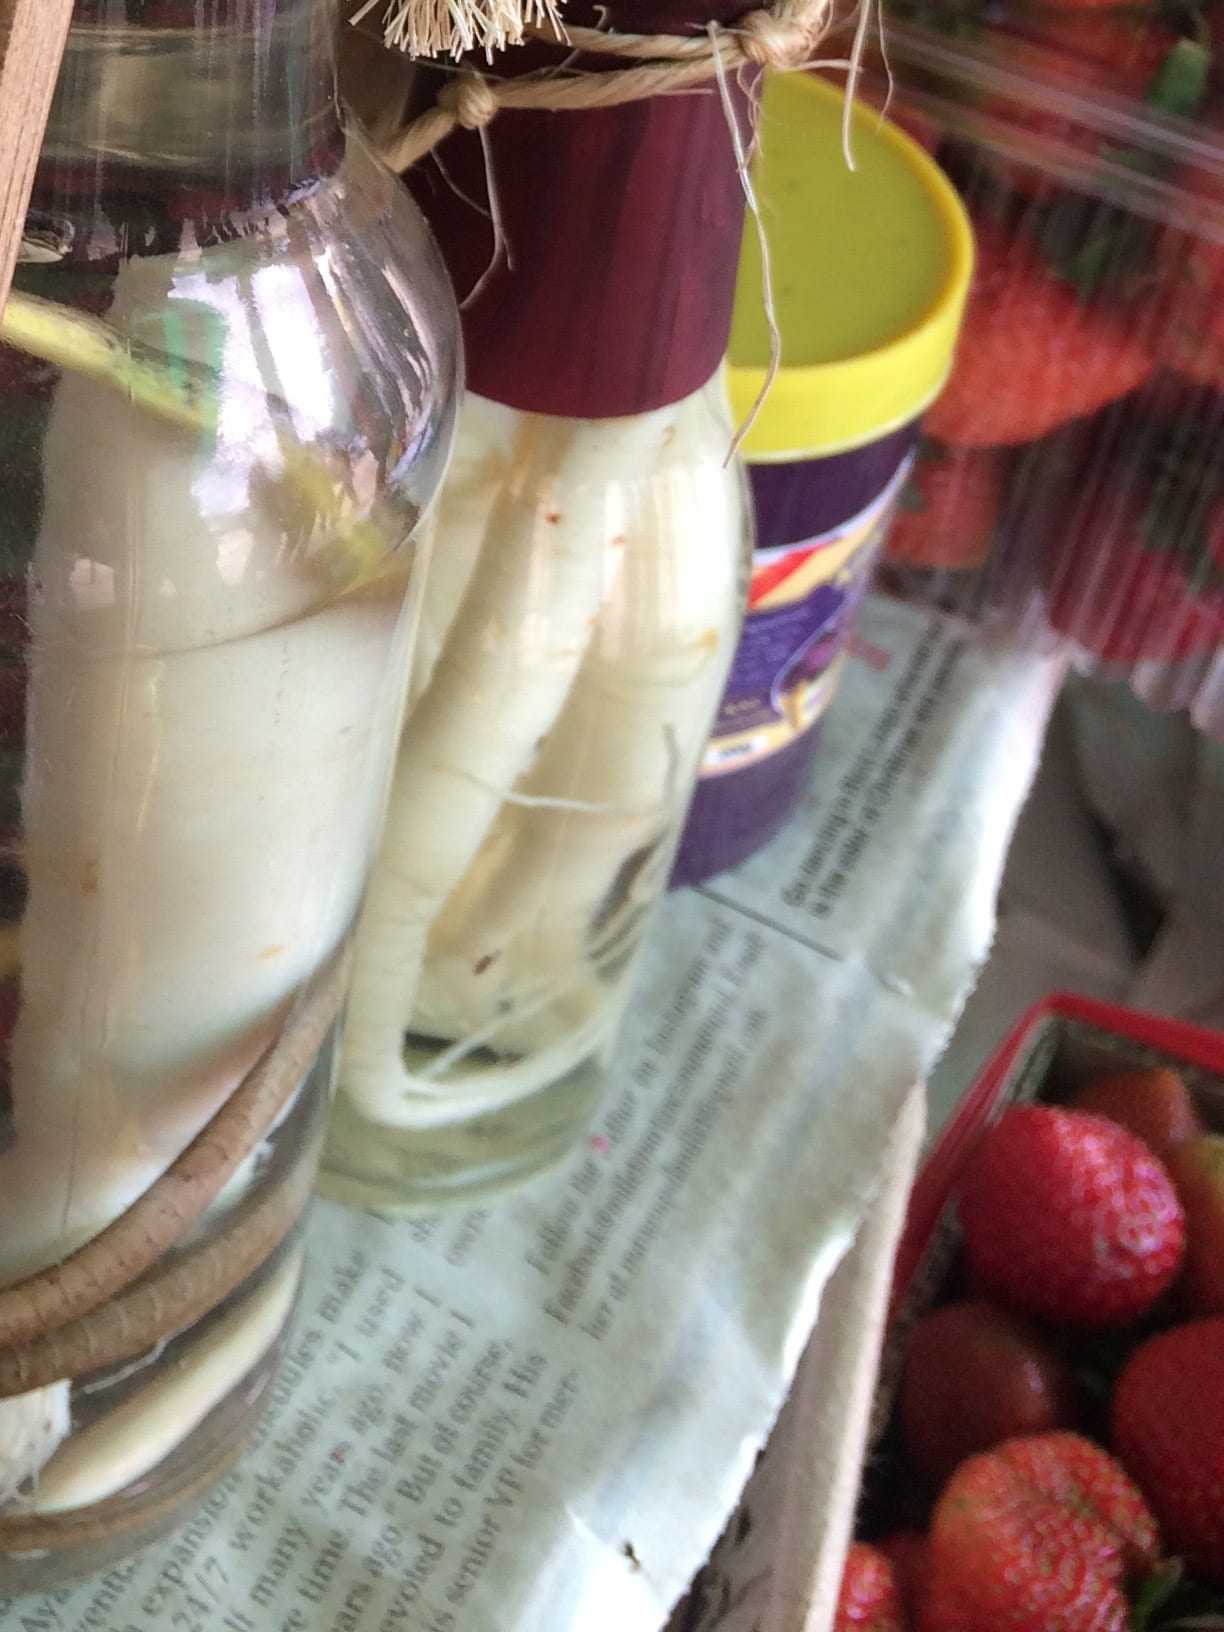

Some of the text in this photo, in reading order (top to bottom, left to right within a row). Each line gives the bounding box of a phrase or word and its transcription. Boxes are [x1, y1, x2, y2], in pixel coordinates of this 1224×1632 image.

[317, 1249, 366, 1323] make
[357, 1266, 405, 1338] used
[249, 1516, 310, 1607] many
[382, 1313, 424, 1374] now
[339, 1467, 381, 1516] The
[371, 1414, 418, 1463] last
[408, 1330, 463, 1411] movie
[395, 1454, 439, 1503] But
[433, 1421, 458, 1454] of
[433, 1497, 463, 1527] to
[502, 1354, 547, 1398] His
[444, 1512, 503, 1607] senior
[484, 1467, 523, 1506] VP
[510, 1428, 549, 1469] for
